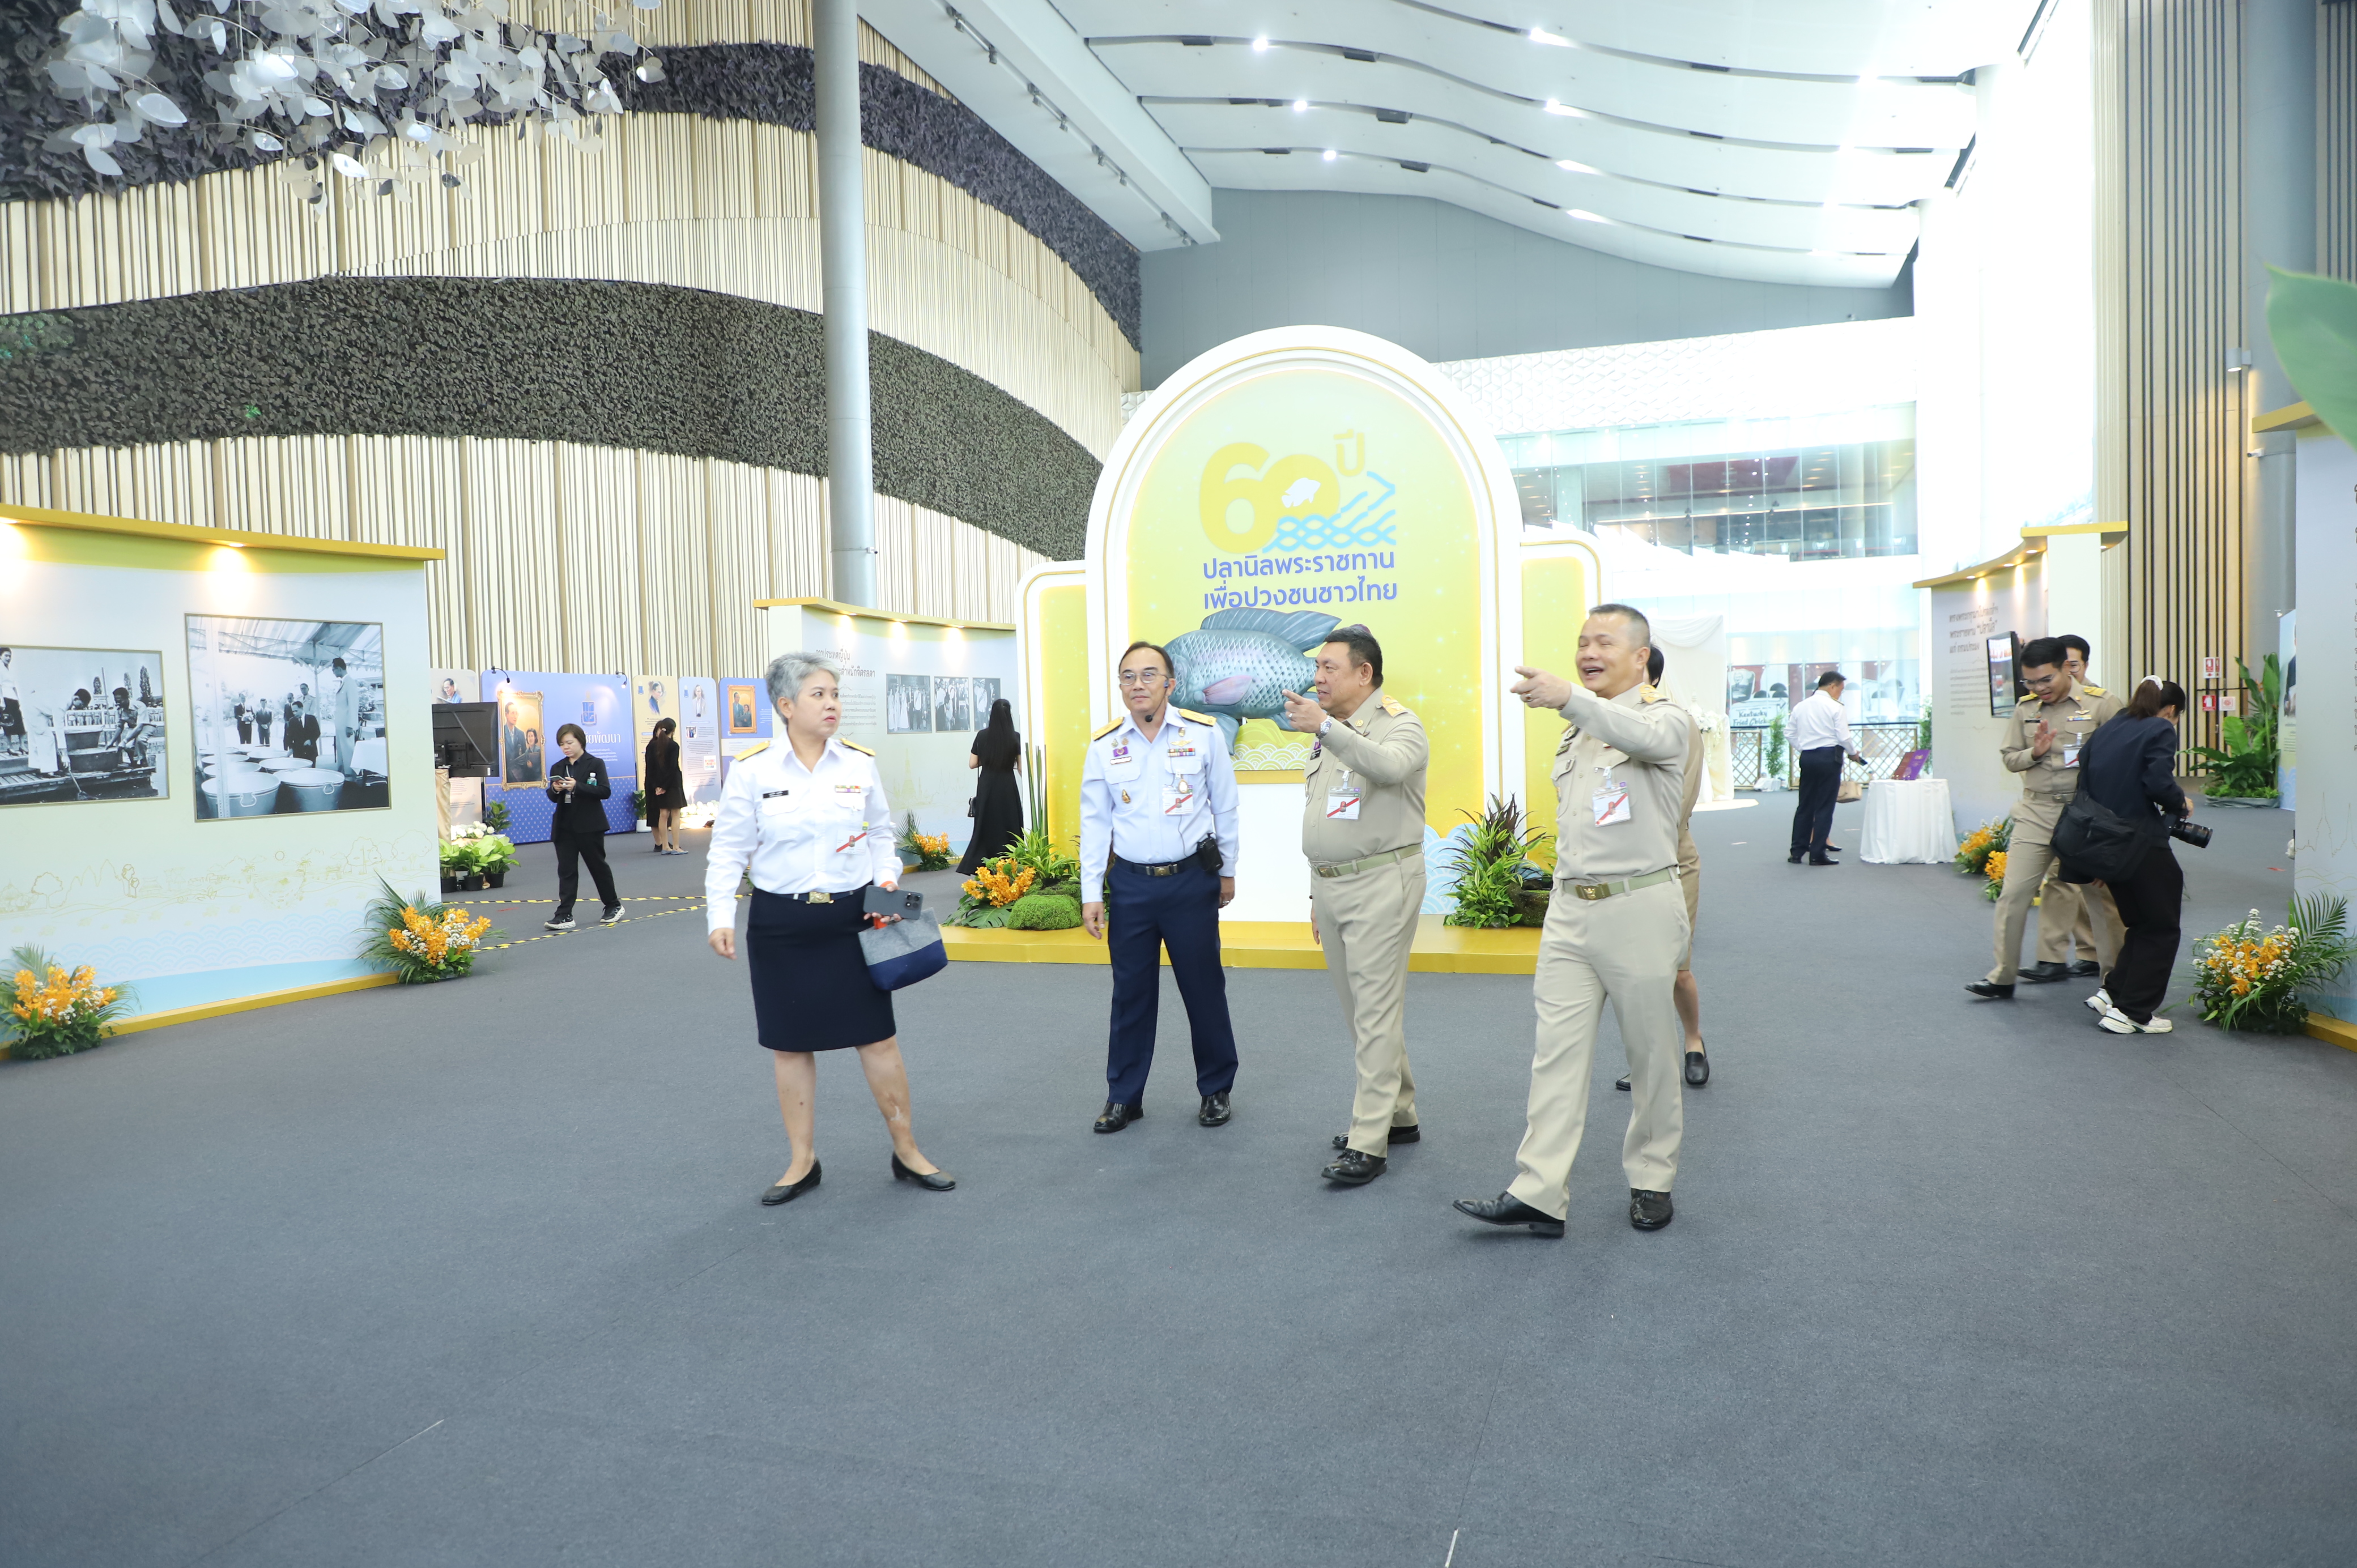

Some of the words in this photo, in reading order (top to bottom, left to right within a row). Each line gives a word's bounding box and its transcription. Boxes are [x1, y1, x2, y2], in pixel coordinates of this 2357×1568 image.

[1199, 442, 1340, 553] 60
[1334, 429, 1365, 477] ปี
[1203, 551, 1395, 579] ปลานิลพระราชทาน
[1204, 576, 1397, 610] เพื่อปวงชนชาวไทย
[839, 664, 875, 678] ะตำหนักจิตรลดา
